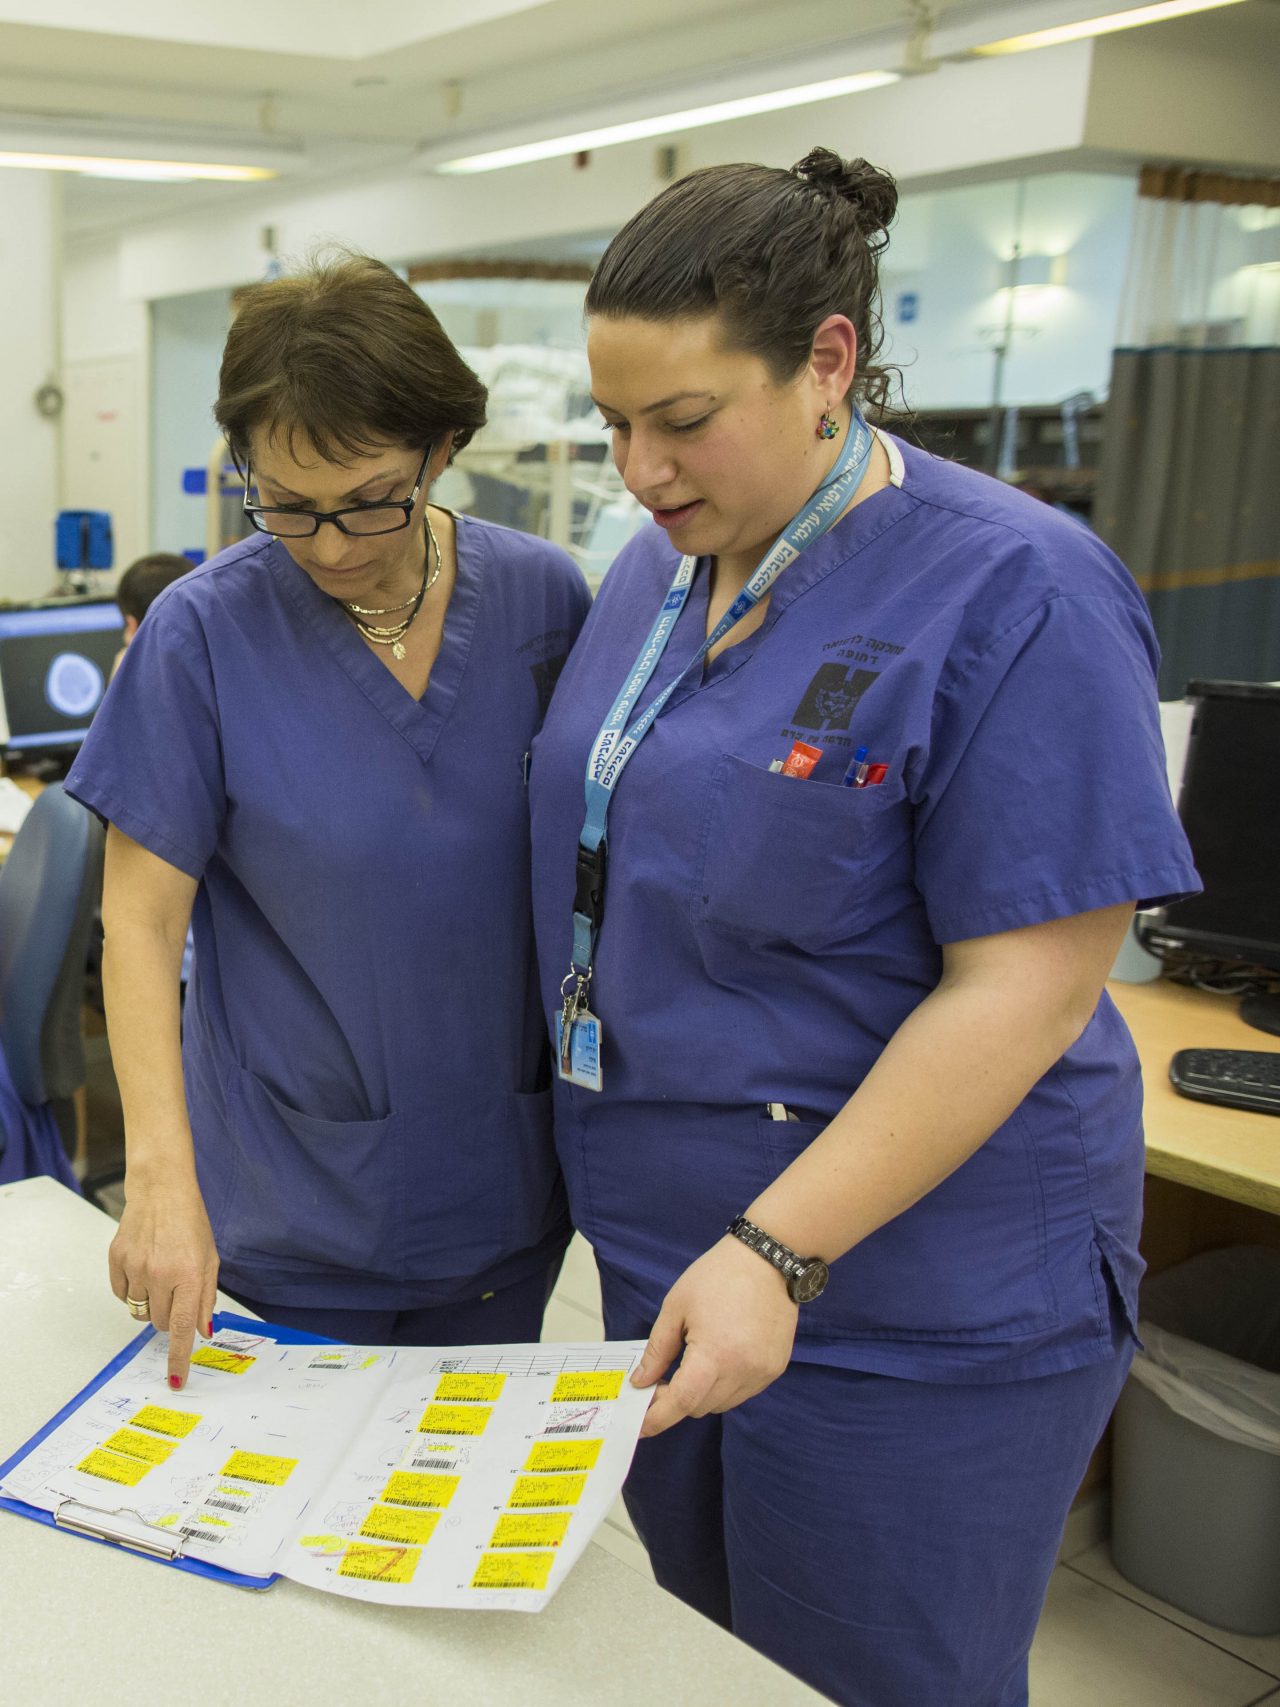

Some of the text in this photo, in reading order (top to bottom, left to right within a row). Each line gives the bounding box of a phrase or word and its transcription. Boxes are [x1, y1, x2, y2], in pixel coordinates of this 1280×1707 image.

[815, 483, 845, 514] רפואי
[792, 512, 821, 543] עולמי
[751, 546, 794, 593] בשבילכם
[610, 616, 672, 726] הדסה-מרכז רפואי עולמי
[633, 709, 655, 735] עולמי
[603, 742, 632, 786] בשבילכם
